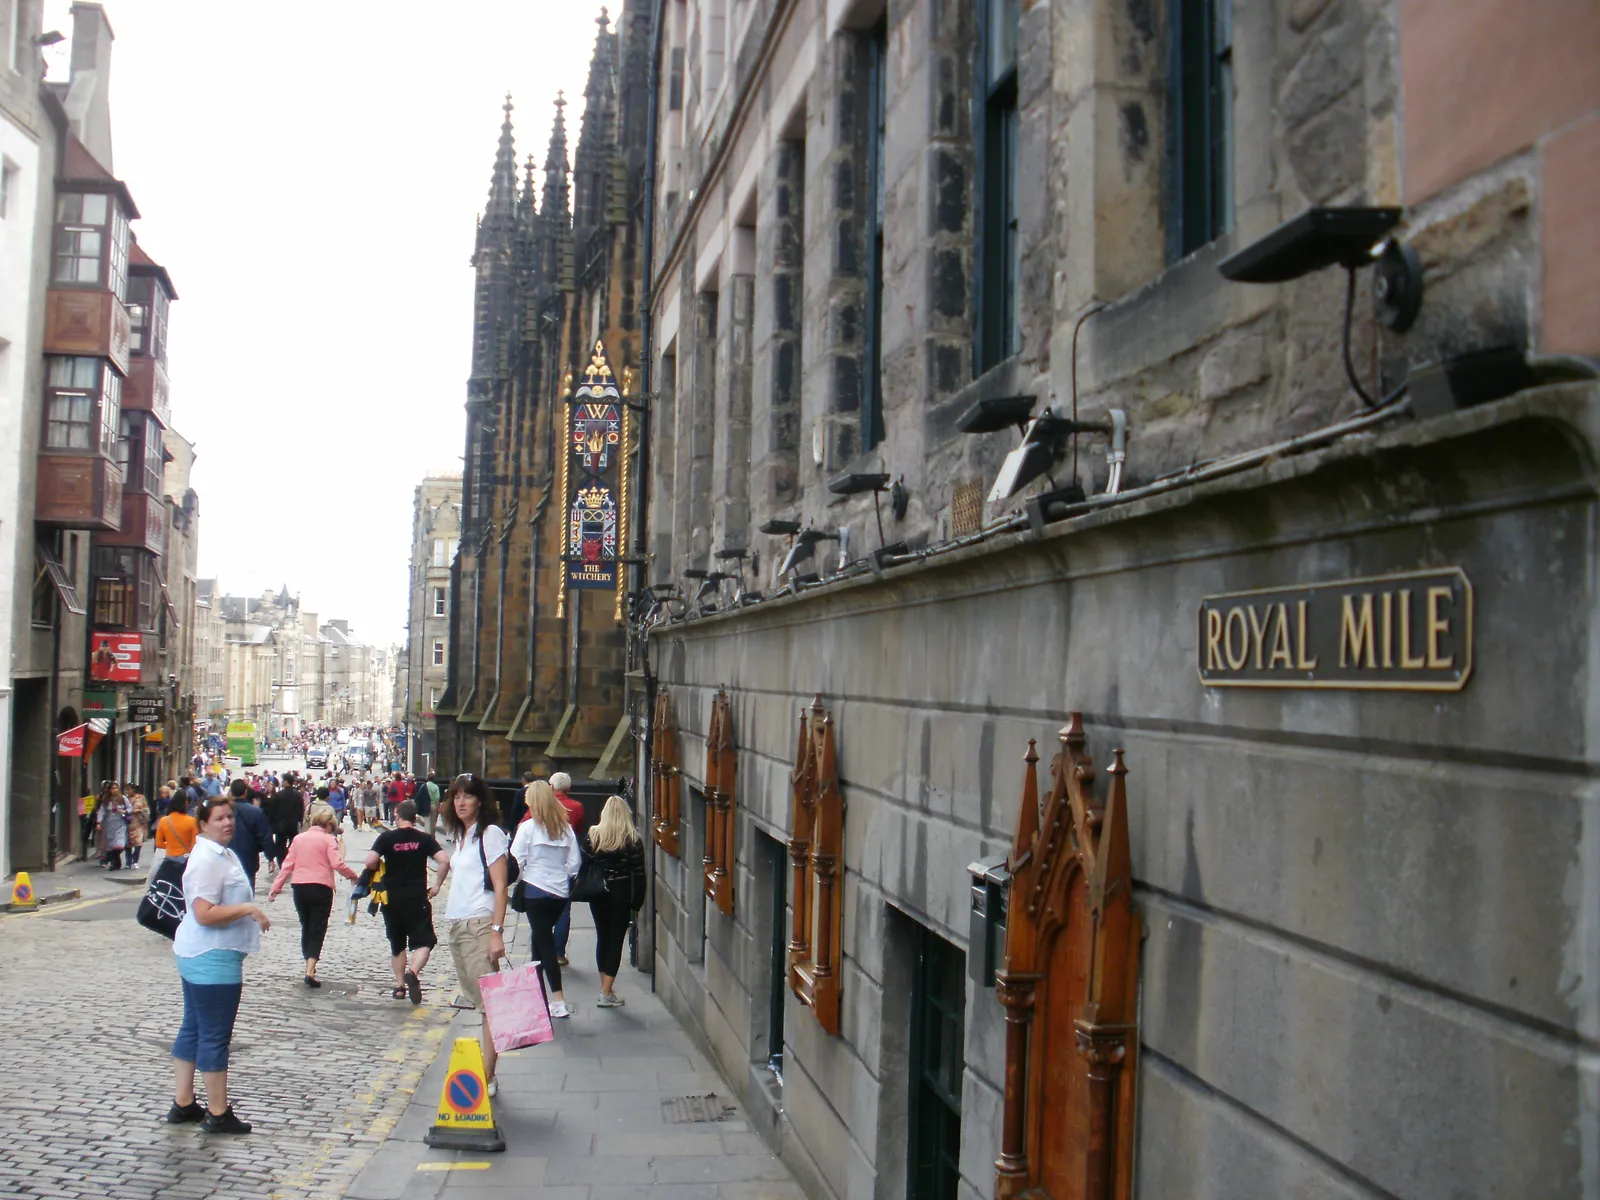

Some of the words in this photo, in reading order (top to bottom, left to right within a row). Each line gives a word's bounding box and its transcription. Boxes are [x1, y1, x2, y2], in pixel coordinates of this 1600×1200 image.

[571, 572, 612, 581] WITCHERY
[1207, 600, 1319, 671] ROYAL
[1339, 586, 1454, 670] MILE
[438, 1113, 450, 1121] NO
[455, 1113, 490, 1122] LOADING
